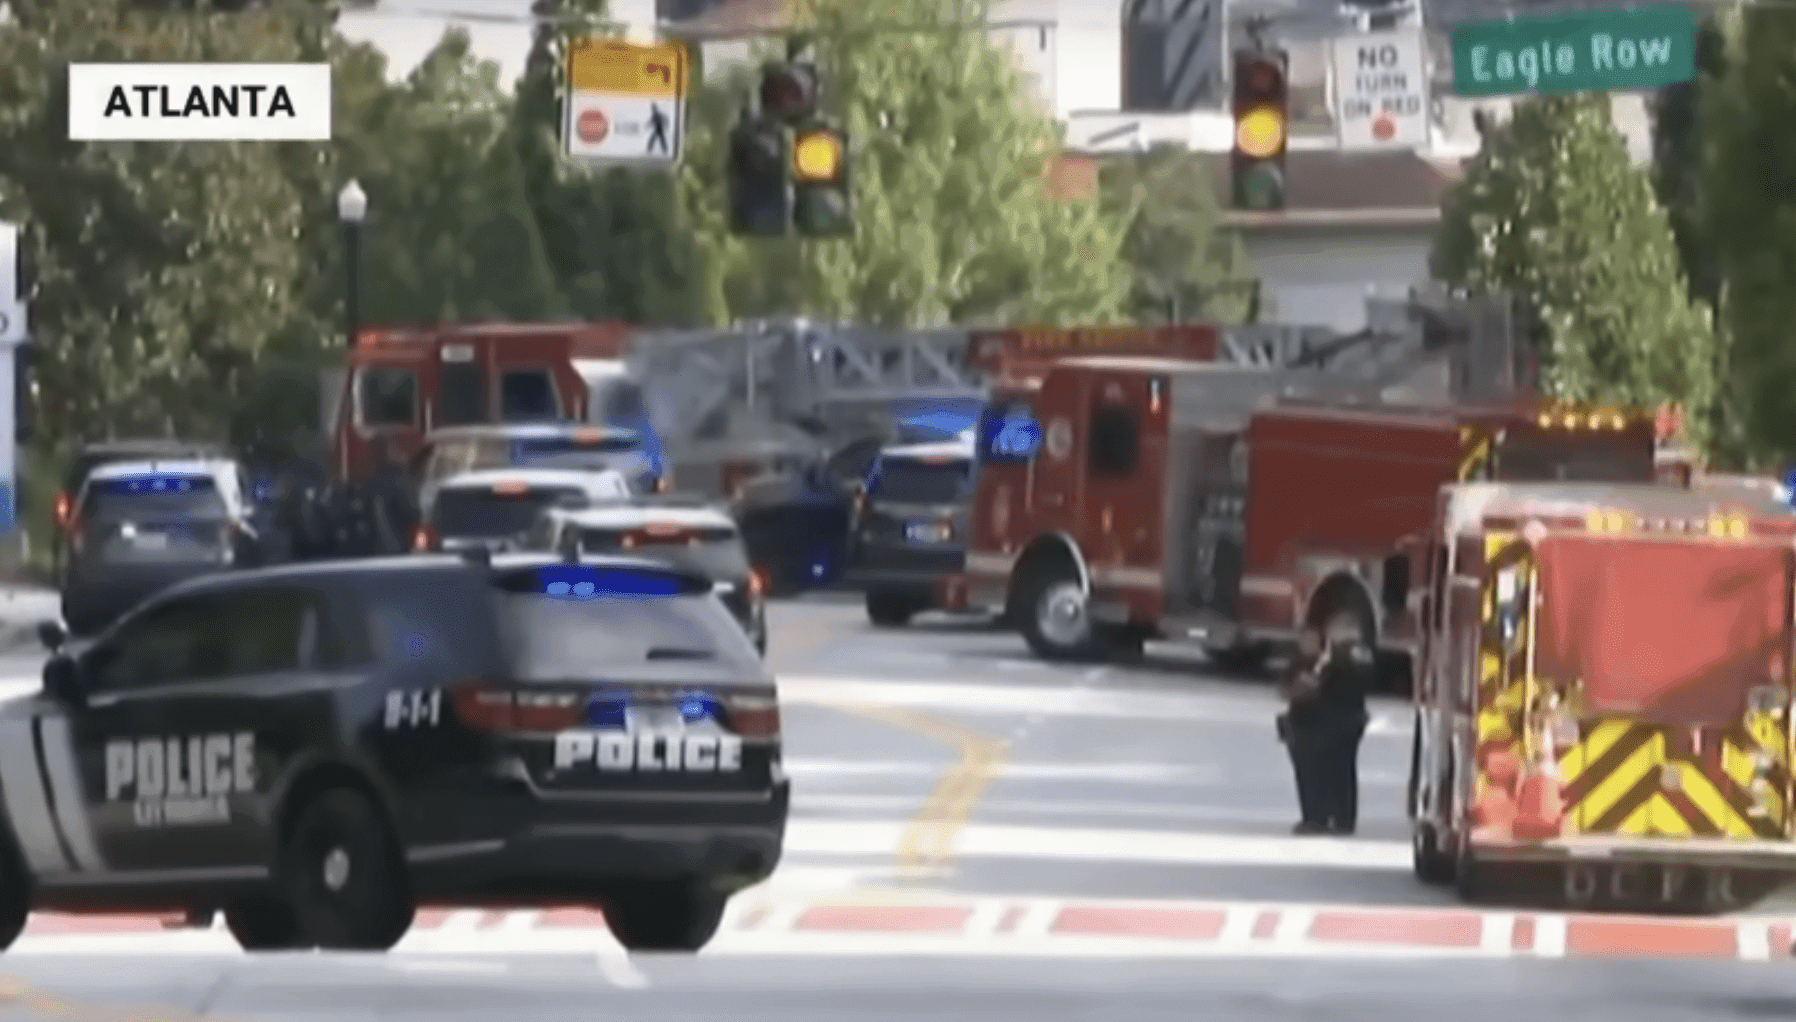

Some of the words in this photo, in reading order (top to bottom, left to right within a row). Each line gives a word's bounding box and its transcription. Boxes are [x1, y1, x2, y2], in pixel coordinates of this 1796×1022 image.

[1357, 45, 1398, 69] NO
[1471, 40, 1576, 87] Eagle
[1591, 32, 1672, 70] Row
[1355, 73, 1407, 93] TURN
[105, 731, 256, 801] POLICE
[554, 731, 743, 772] POLICE
